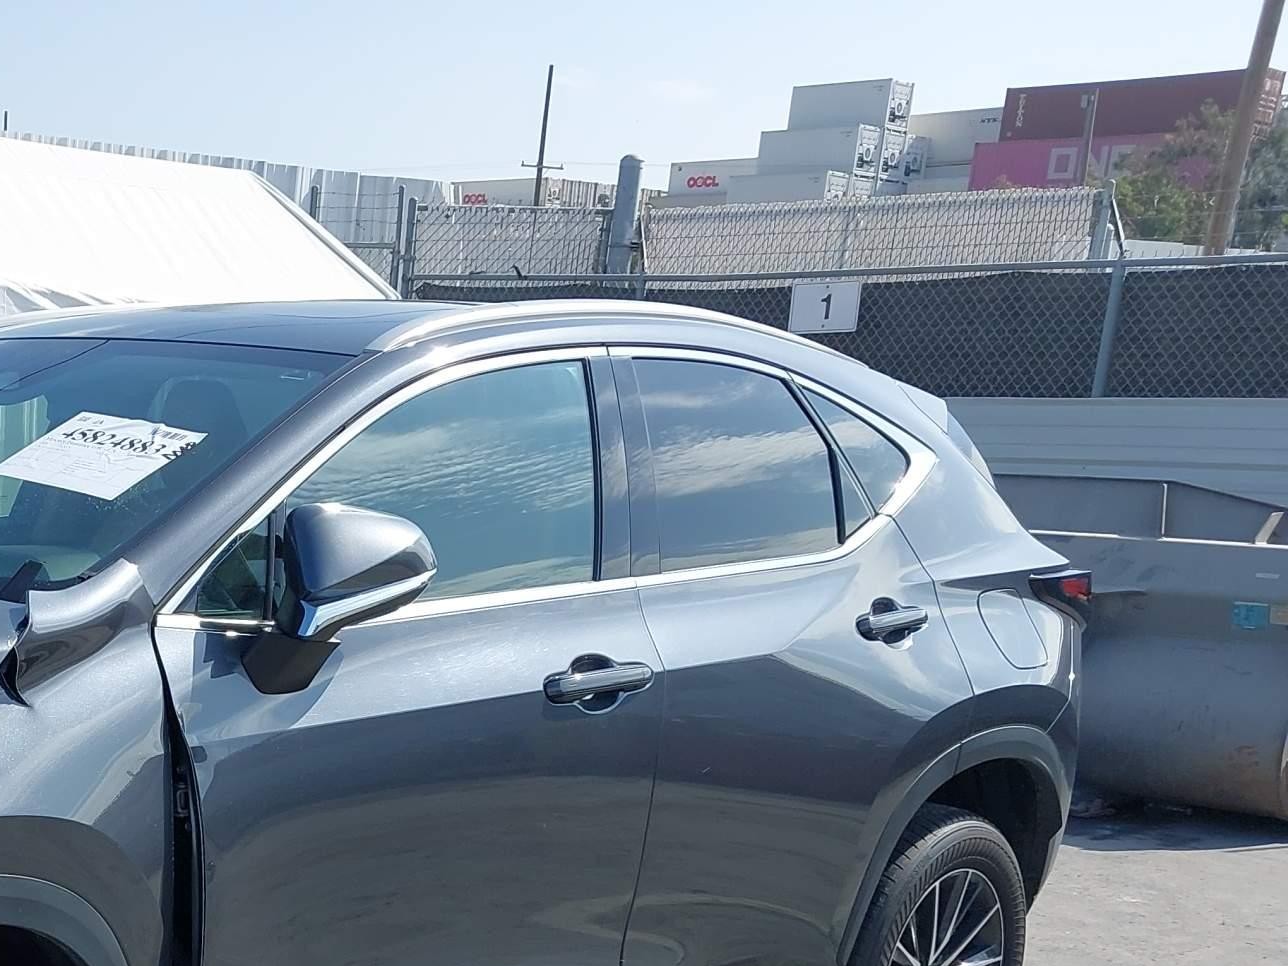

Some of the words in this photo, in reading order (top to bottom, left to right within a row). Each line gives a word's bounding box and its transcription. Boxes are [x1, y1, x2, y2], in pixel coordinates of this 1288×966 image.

[687, 176, 720, 188] OOCL
[821, 293, 832, 320] 1
[62, 427, 167, 455] 45824883
